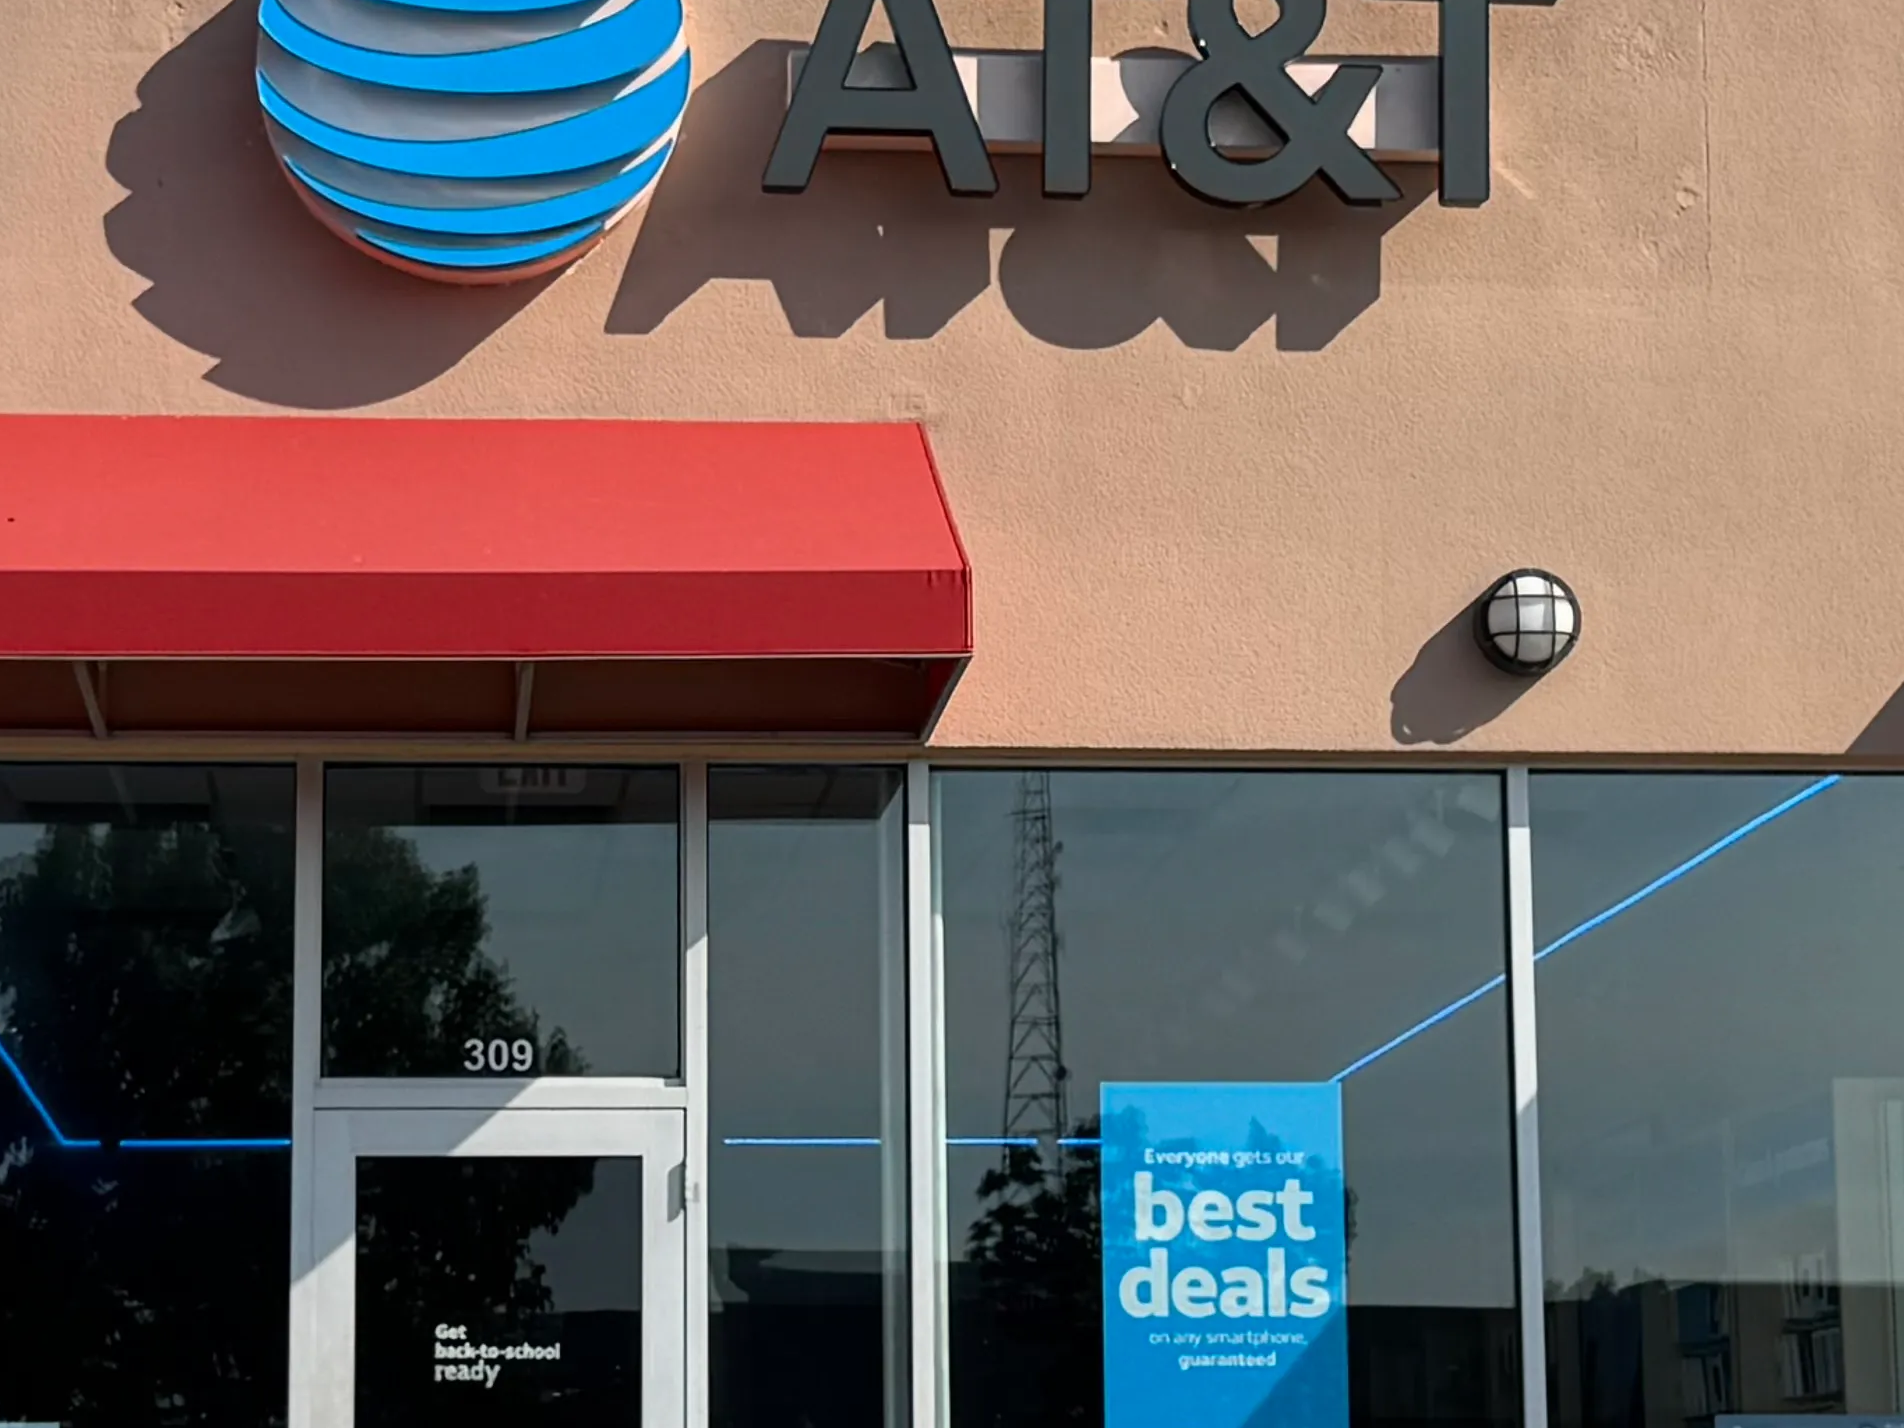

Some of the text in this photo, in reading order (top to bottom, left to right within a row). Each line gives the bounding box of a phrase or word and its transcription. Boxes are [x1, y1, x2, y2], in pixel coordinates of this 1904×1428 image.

[463, 1039, 534, 1071] 309
[1144, 1147, 1305, 1168] Everyone gets our
[1133, 1171, 1316, 1241] best
[1118, 1247, 1331, 1318] deals
[435, 1324, 467, 1339] Get
[1149, 1333, 1170, 1344] on
[1173, 1333, 1201, 1347] any
[435, 1342, 561, 1360] back-to-school
[1178, 1353, 1276, 1370] guaranteed
[435, 1359, 500, 1388] ready
